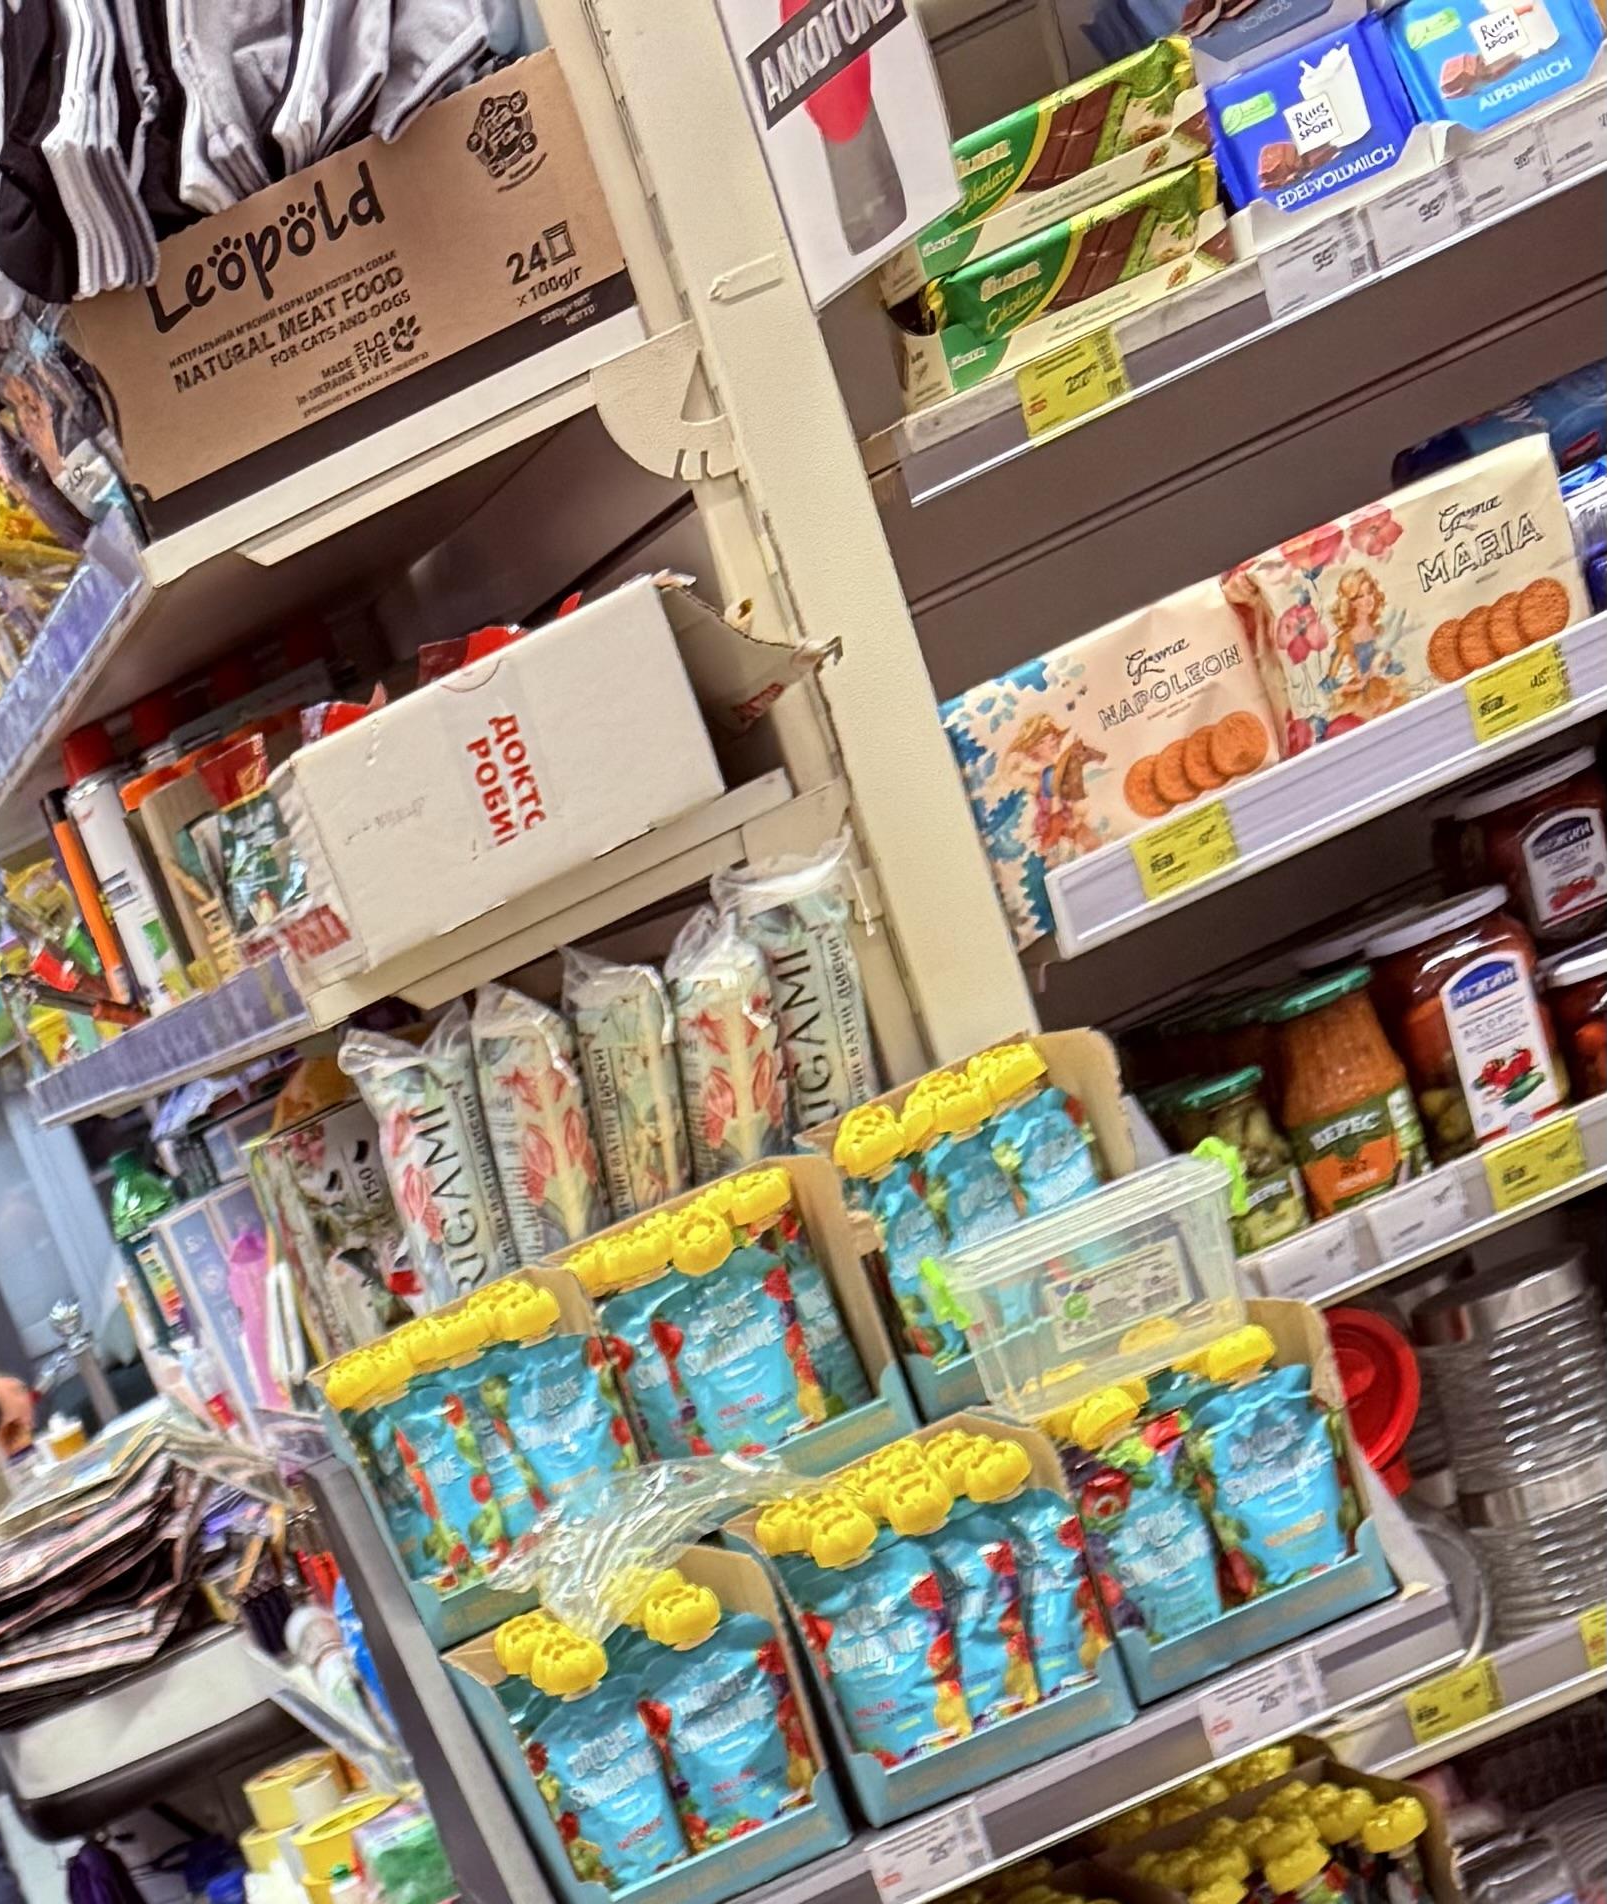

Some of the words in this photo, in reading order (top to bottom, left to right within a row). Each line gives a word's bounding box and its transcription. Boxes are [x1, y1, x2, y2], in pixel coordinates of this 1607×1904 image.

[1484, 27, 1523, 52] SPORT
[1479, 57, 1572, 112] ALPENMILCH
[1299, 117, 1334, 142] SPORT
[506, 242, 547, 285] 24
[174, 331, 275, 394] NATURAL
[279, 297, 339, 341] MEAT
[341, 266, 404, 310] FOOD
[270, 346, 299, 368] FOR
[301, 326, 336, 352] CATS
[339, 309, 368, 333] AND
[369, 288, 411, 318] DOGS
[321, 358, 354, 379] MADE
[1417, 512, 1545, 592] MARIA
[1098, 643, 1244, 731] NAPOLEON
[410, 1106, 489, 1290] RIGAMI
